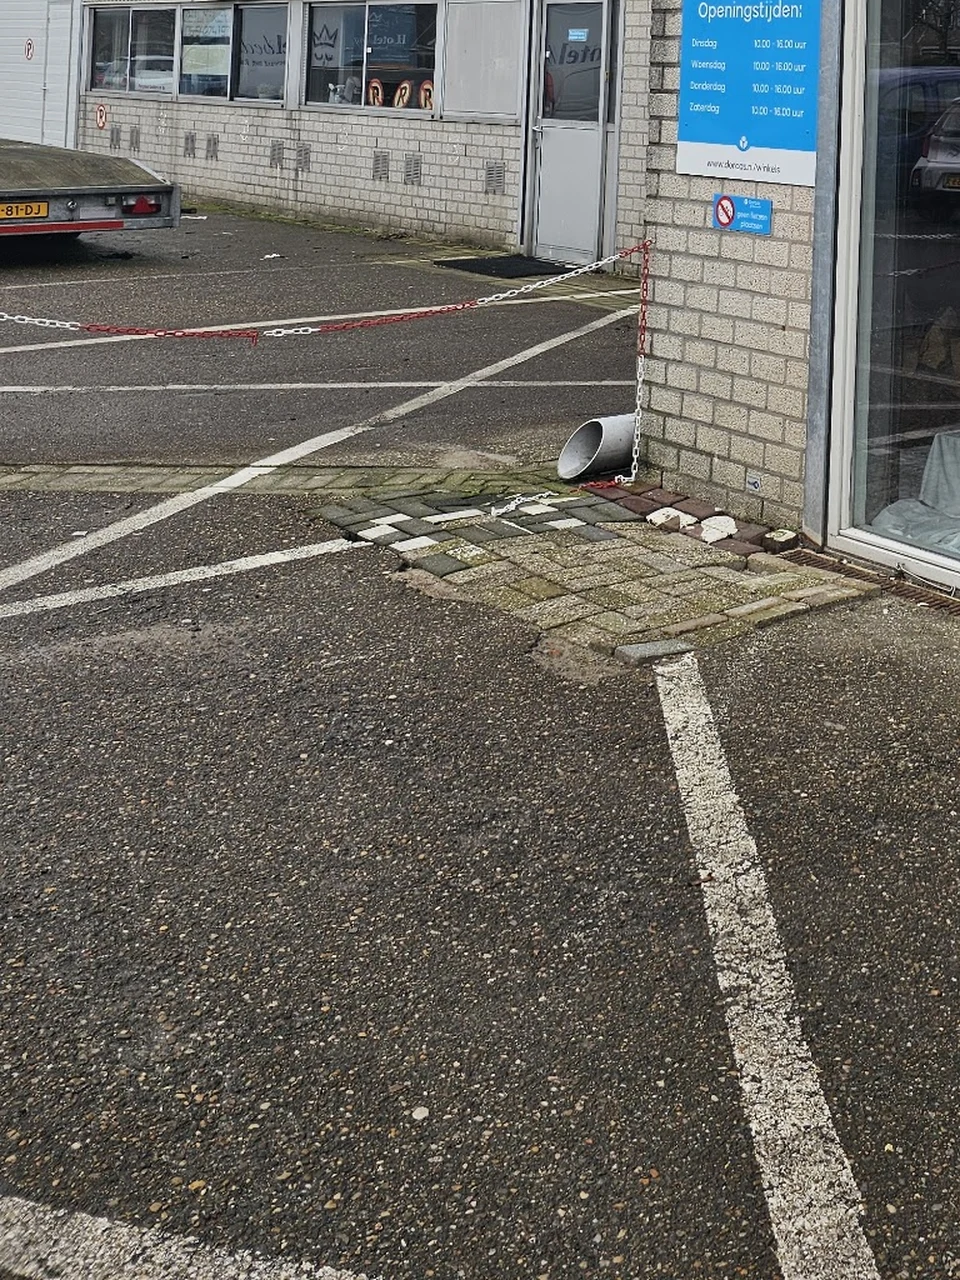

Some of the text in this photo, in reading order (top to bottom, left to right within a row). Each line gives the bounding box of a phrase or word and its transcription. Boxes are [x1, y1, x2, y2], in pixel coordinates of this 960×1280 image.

[698, 0, 803, 23] Openingstijden:
[691, 38, 717, 50] Dinsdag
[753, 39, 770, 49] 10.00
[776, 39, 793, 49] 16.00
[794, 41, 807, 50] uur
[690, 59, 726, 72] Woensdag
[753, 61, 770, 71] 10.00
[775, 62, 792, 72] 16.00
[793, 64, 806, 72] uur
[690, 81, 726, 93] Donderdag
[752, 83, 769, 93] 10.00
[774, 84, 792, 94] 16.00
[793, 86, 805, 95] uur
[689, 102, 720, 115] Zaterdag
[751, 106, 768, 116] 10.00
[774, 106, 791, 117] 16.00
[792, 109, 804, 118] uur
